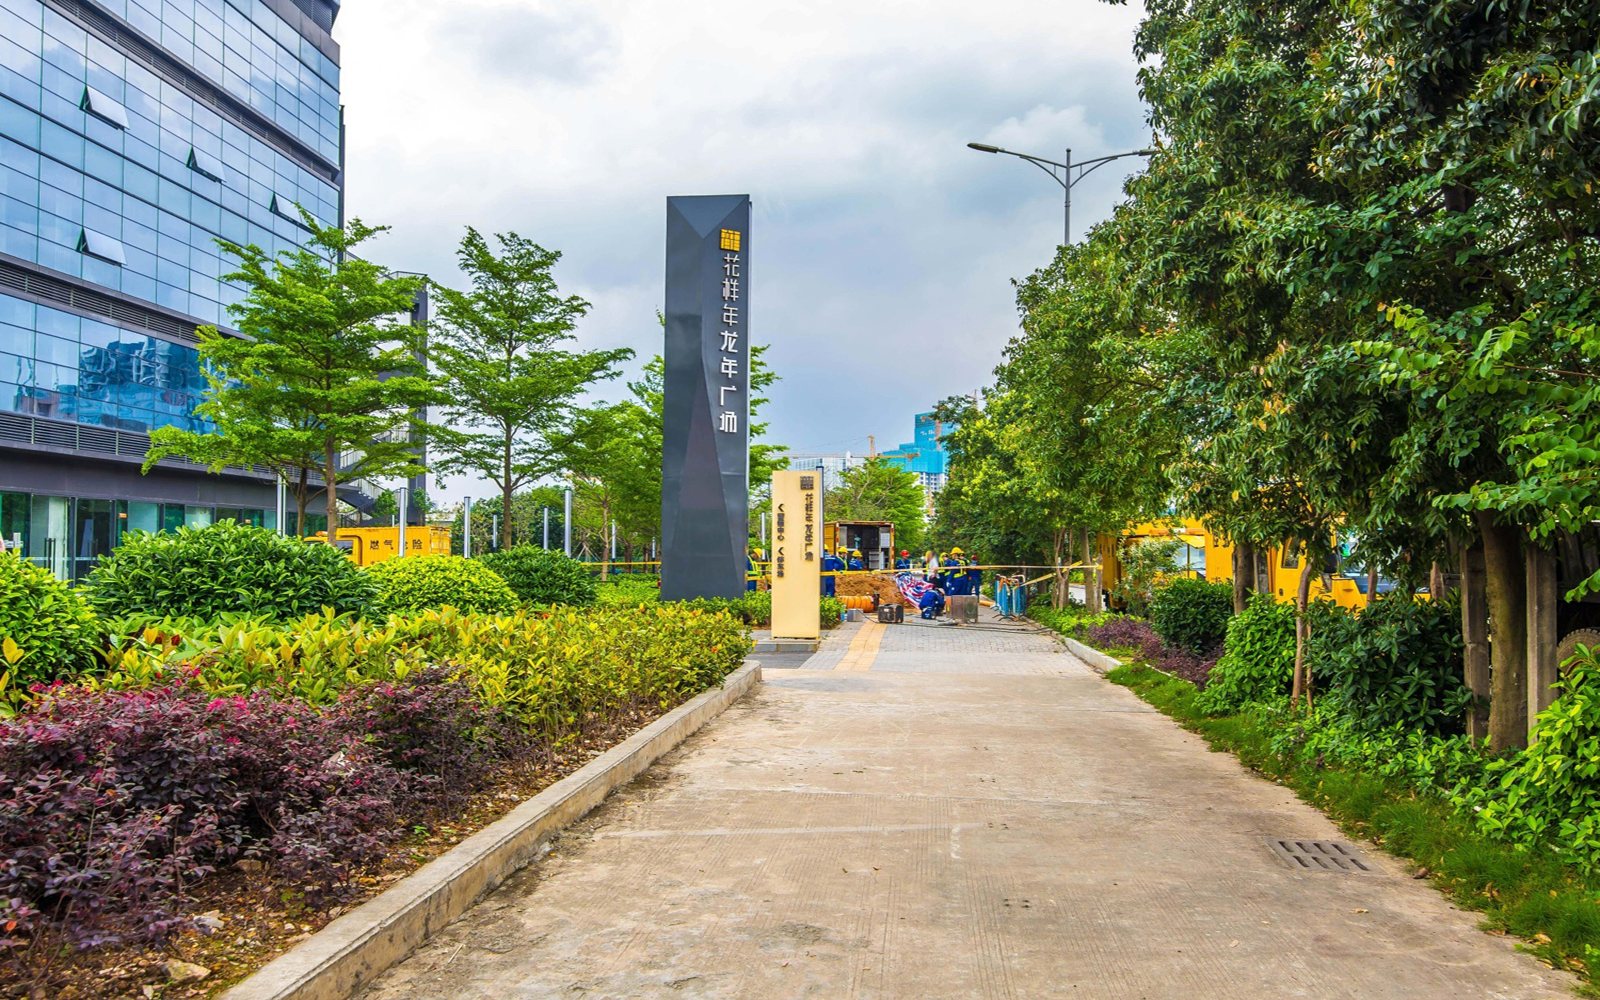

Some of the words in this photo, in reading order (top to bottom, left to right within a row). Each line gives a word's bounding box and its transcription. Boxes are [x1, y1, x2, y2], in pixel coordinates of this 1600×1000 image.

[720, 252, 740, 433] 花样年龙年广场
[369, 538, 423, 550] 燃气险
